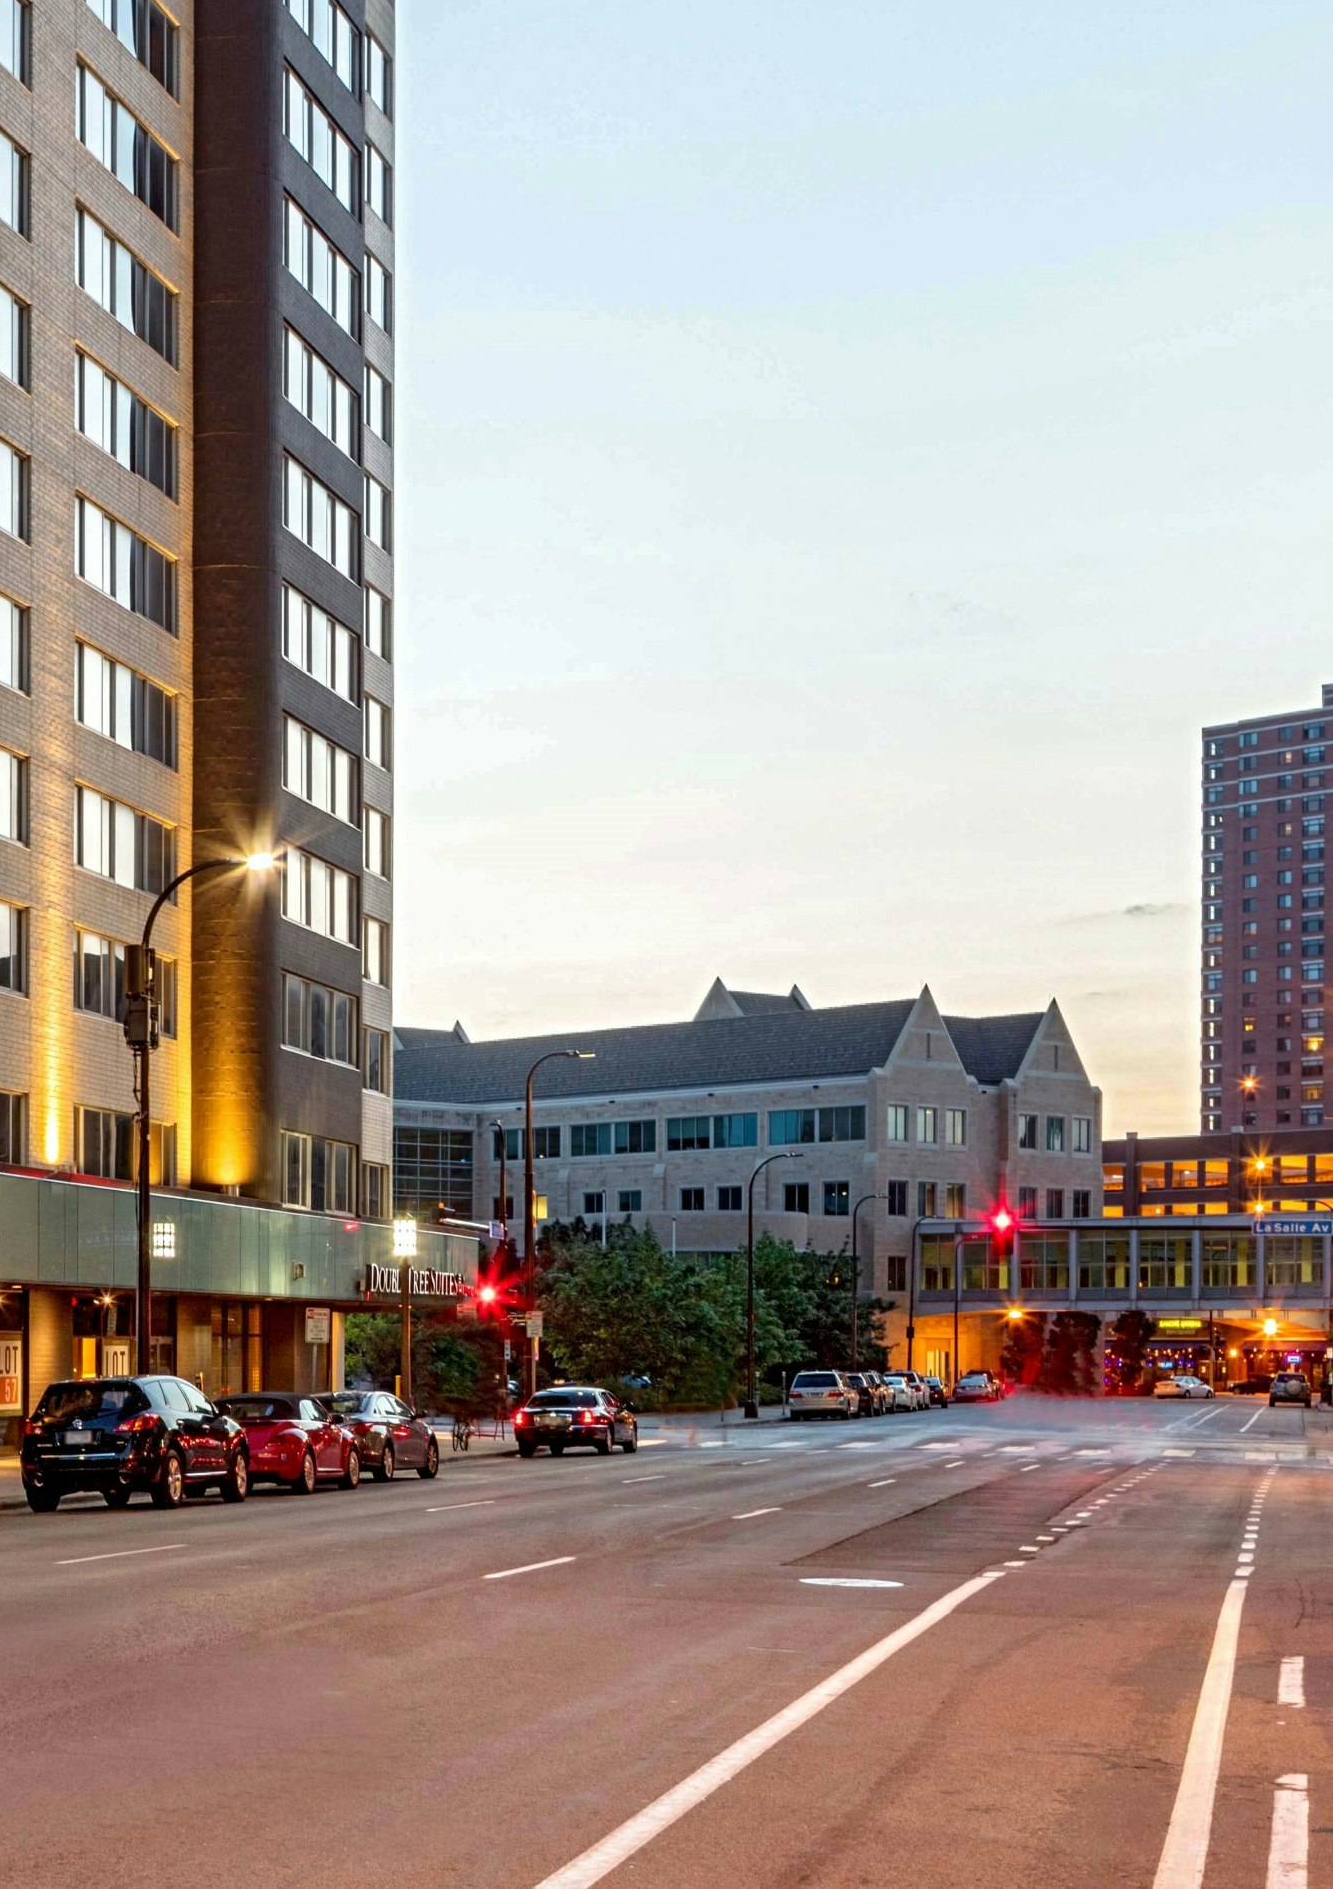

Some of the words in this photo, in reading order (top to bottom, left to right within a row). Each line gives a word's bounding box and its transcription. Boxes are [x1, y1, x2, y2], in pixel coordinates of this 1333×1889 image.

[1312, 1222, 1329, 1232] Av
[371, 1263, 429, 1295] DOUBLTREE
[431, 1267, 458, 1296] SUITES
[4, 1378, 17, 1403] 57
